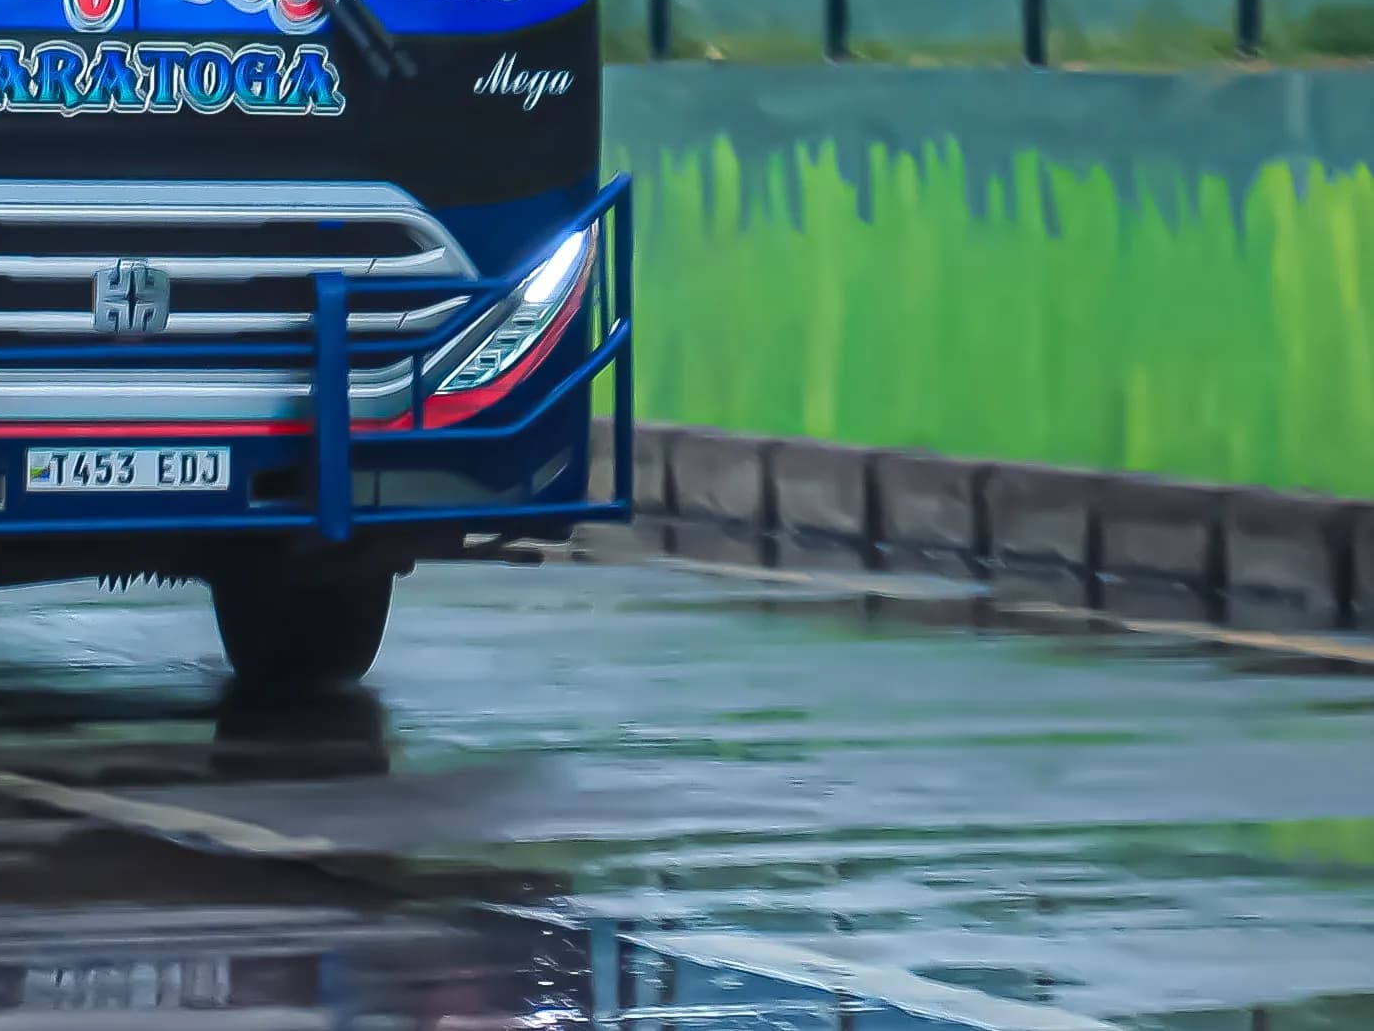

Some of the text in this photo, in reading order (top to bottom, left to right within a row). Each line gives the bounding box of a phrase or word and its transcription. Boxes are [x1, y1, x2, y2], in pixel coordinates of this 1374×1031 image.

[474, 51, 574, 112] Mega
[50, 451, 220, 486] T453 EDJ
